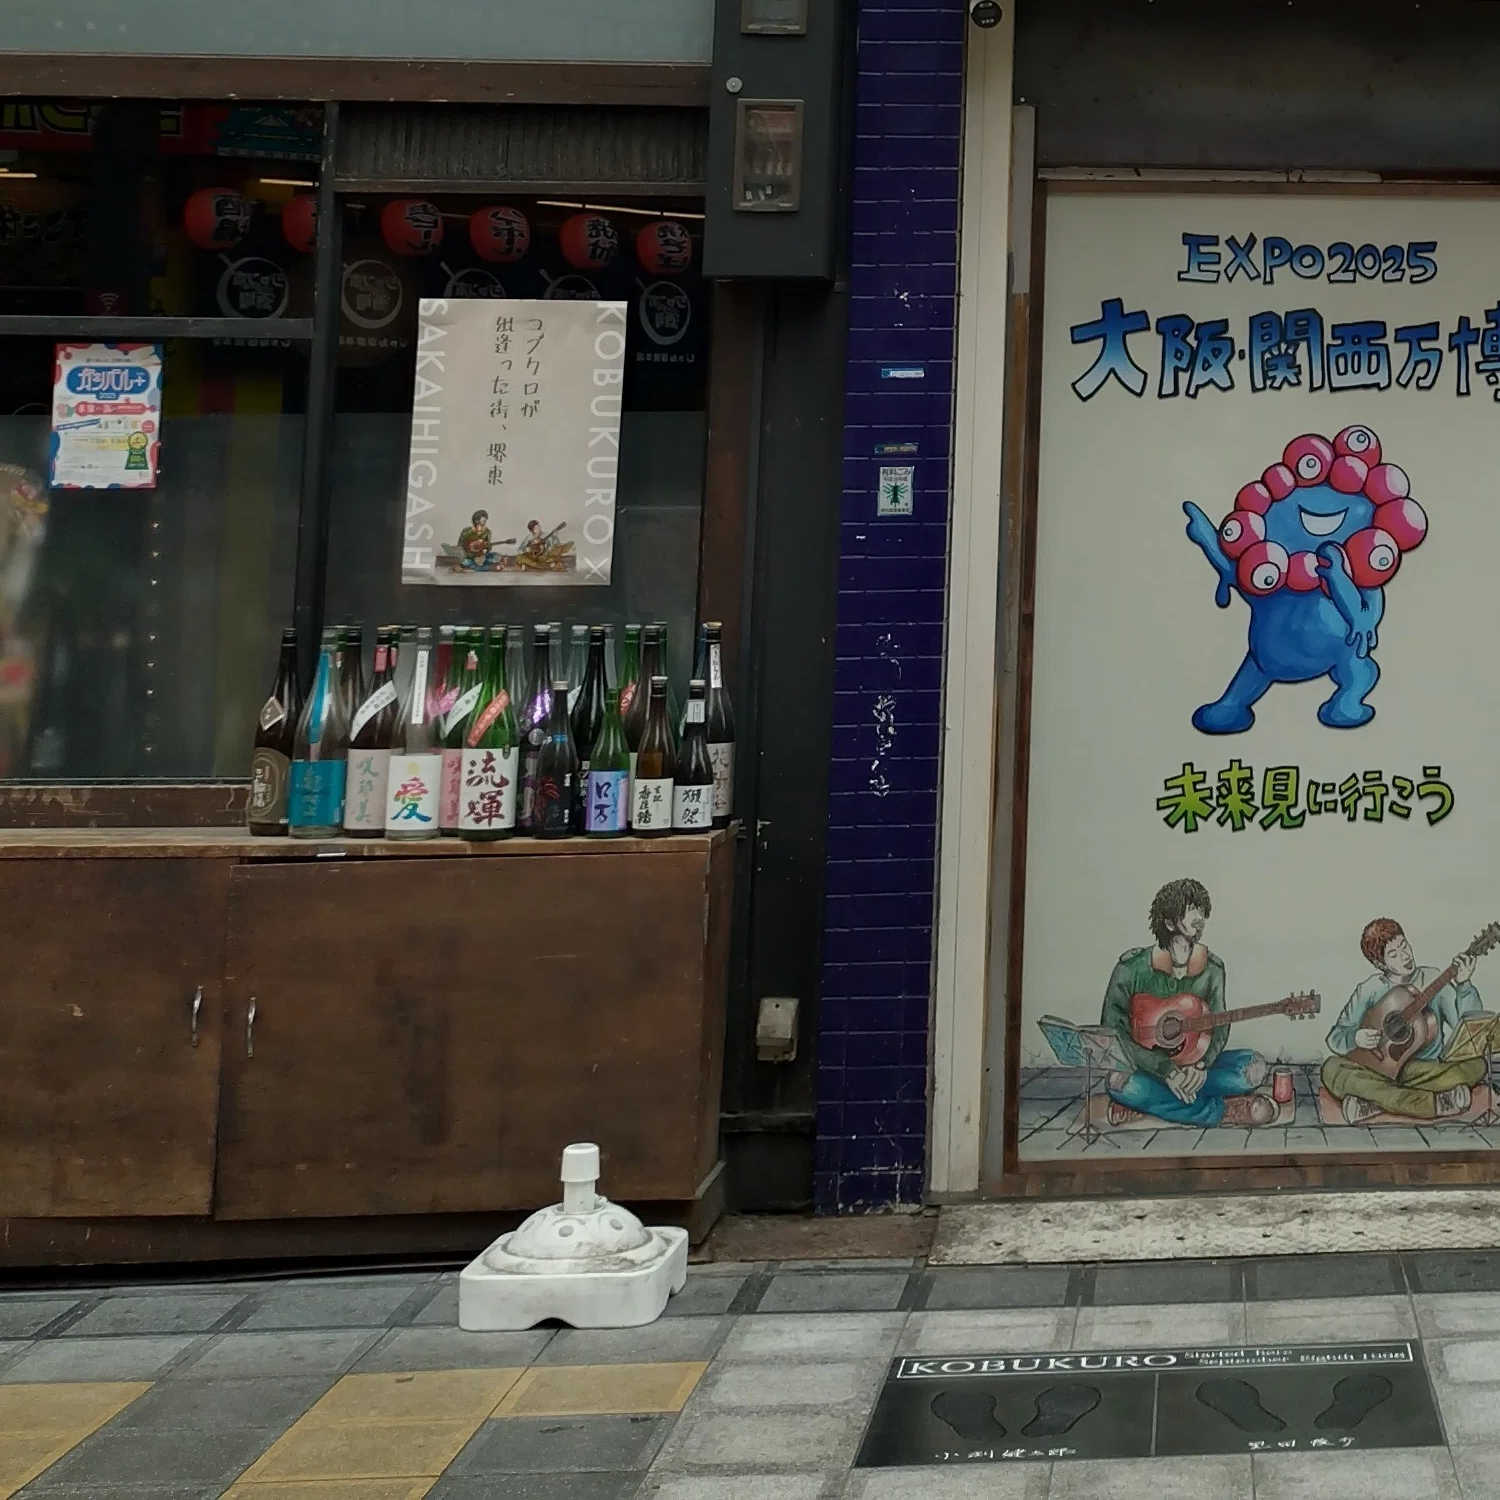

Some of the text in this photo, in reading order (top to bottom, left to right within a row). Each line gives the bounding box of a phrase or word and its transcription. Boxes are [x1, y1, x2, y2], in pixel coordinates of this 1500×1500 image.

[1178, 232, 1438, 284] EXPO2025
[520, 318, 545, 419] コブクロが
[583, 302, 628, 545] KOBUKURO
[1156, 759, 1455, 833] 未来見に行こう
[907, 1353, 1178, 1375] KOBUKURO
